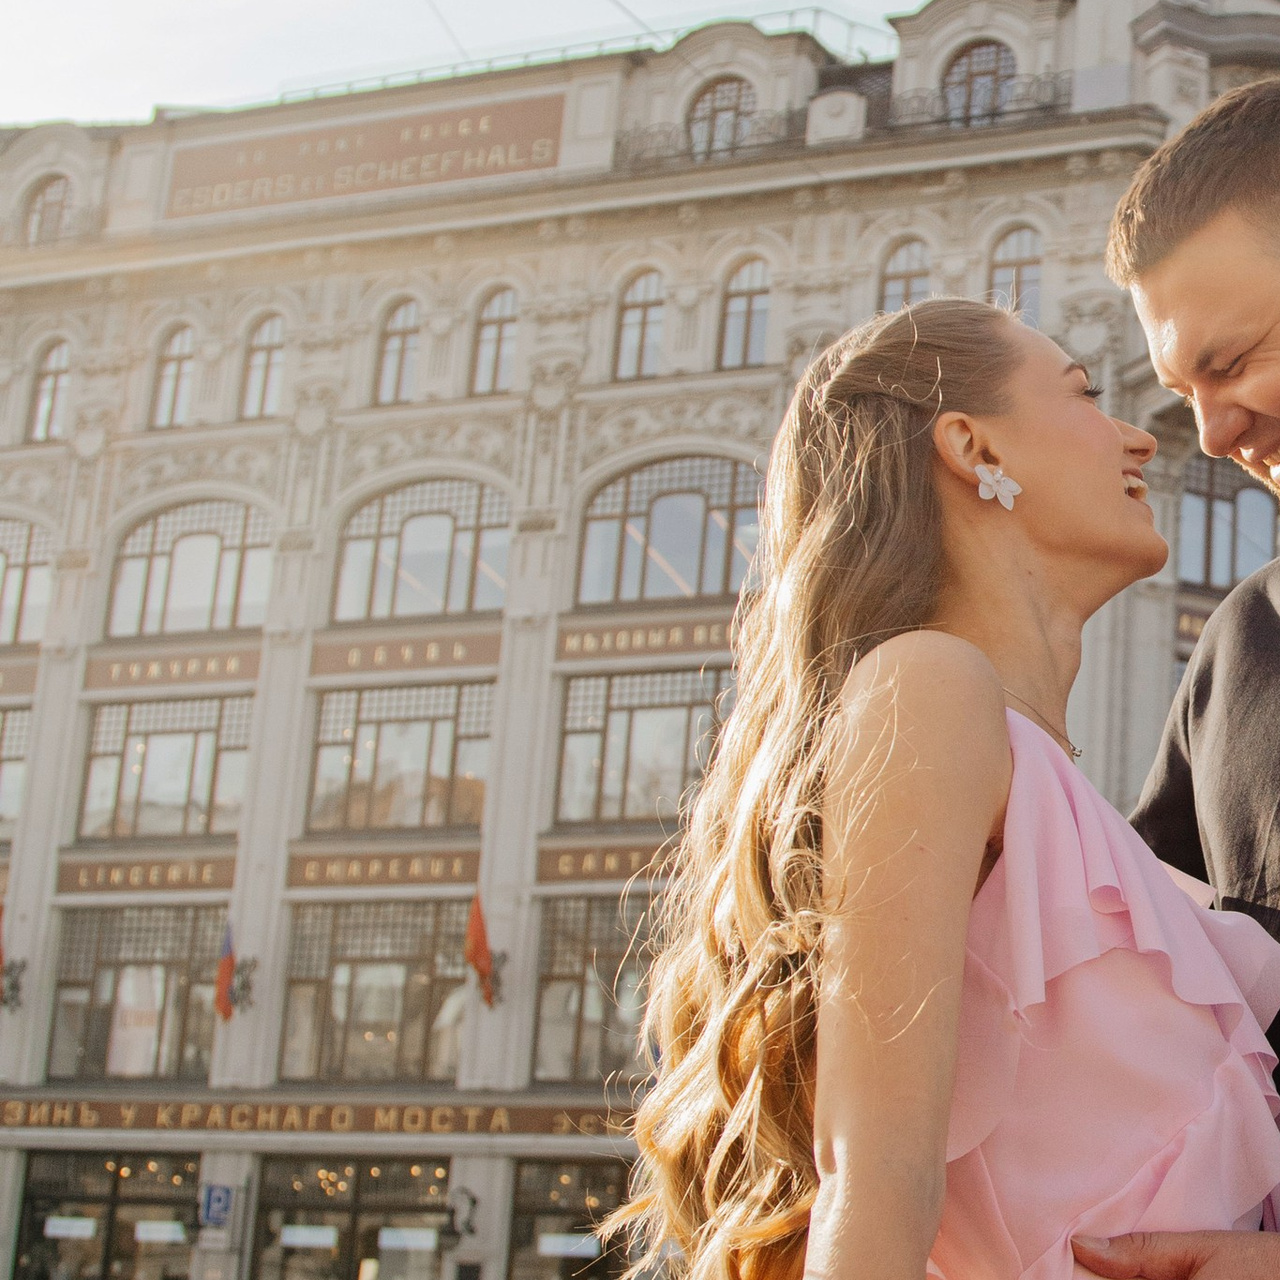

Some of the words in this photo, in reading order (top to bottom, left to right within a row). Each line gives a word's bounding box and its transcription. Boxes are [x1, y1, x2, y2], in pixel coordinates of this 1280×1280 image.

[173, 173, 295, 212] ESDERS
[333, 138, 554, 191] SCHEEFHALS
[79, 863, 215, 887] LINGERIE
[304, 855, 464, 881] CHAPEAUX
[120, 1103, 138, 1129] У
[156, 1103, 355, 1132] КРАСНАГО
[373, 1104, 512, 1133] МОСТА
